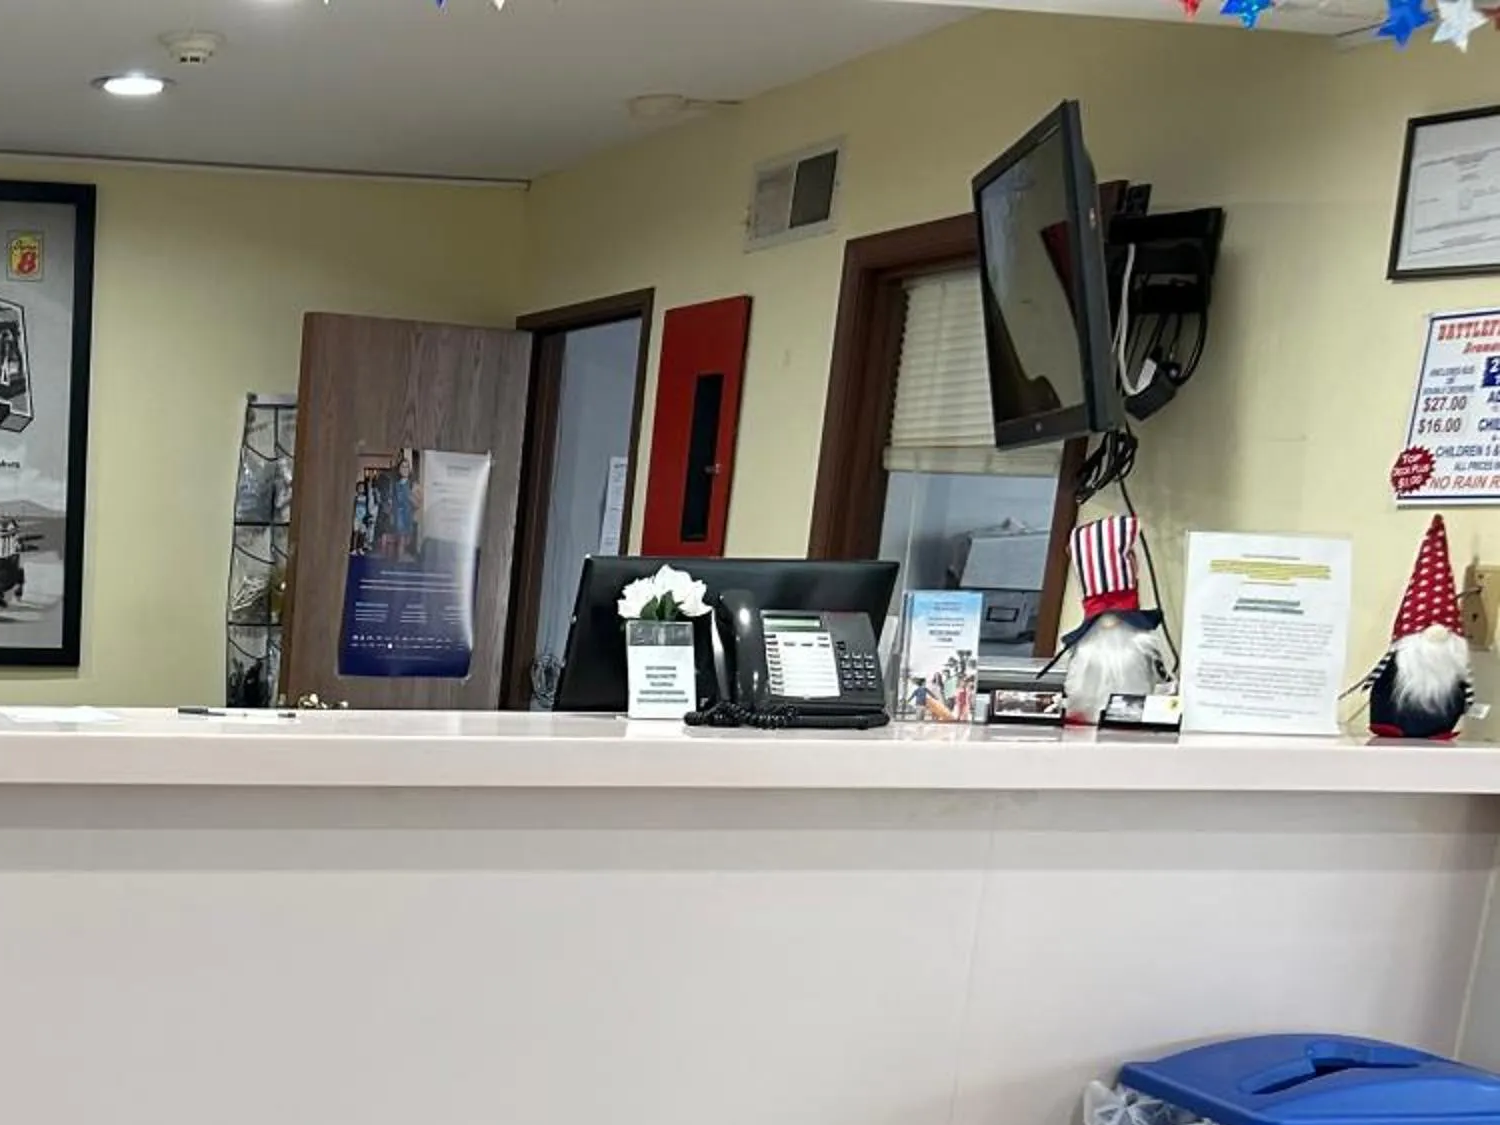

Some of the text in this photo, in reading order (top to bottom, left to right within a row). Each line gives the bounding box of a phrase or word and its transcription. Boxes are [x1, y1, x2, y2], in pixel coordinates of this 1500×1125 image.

[1423, 395, 1468, 413] $27.00
[1417, 417, 1462, 434] $16.00
[1435, 445, 1483, 457] CHILDREN
[1429, 475, 1451, 489] NO
[1453, 475, 1487, 489] RAIN
